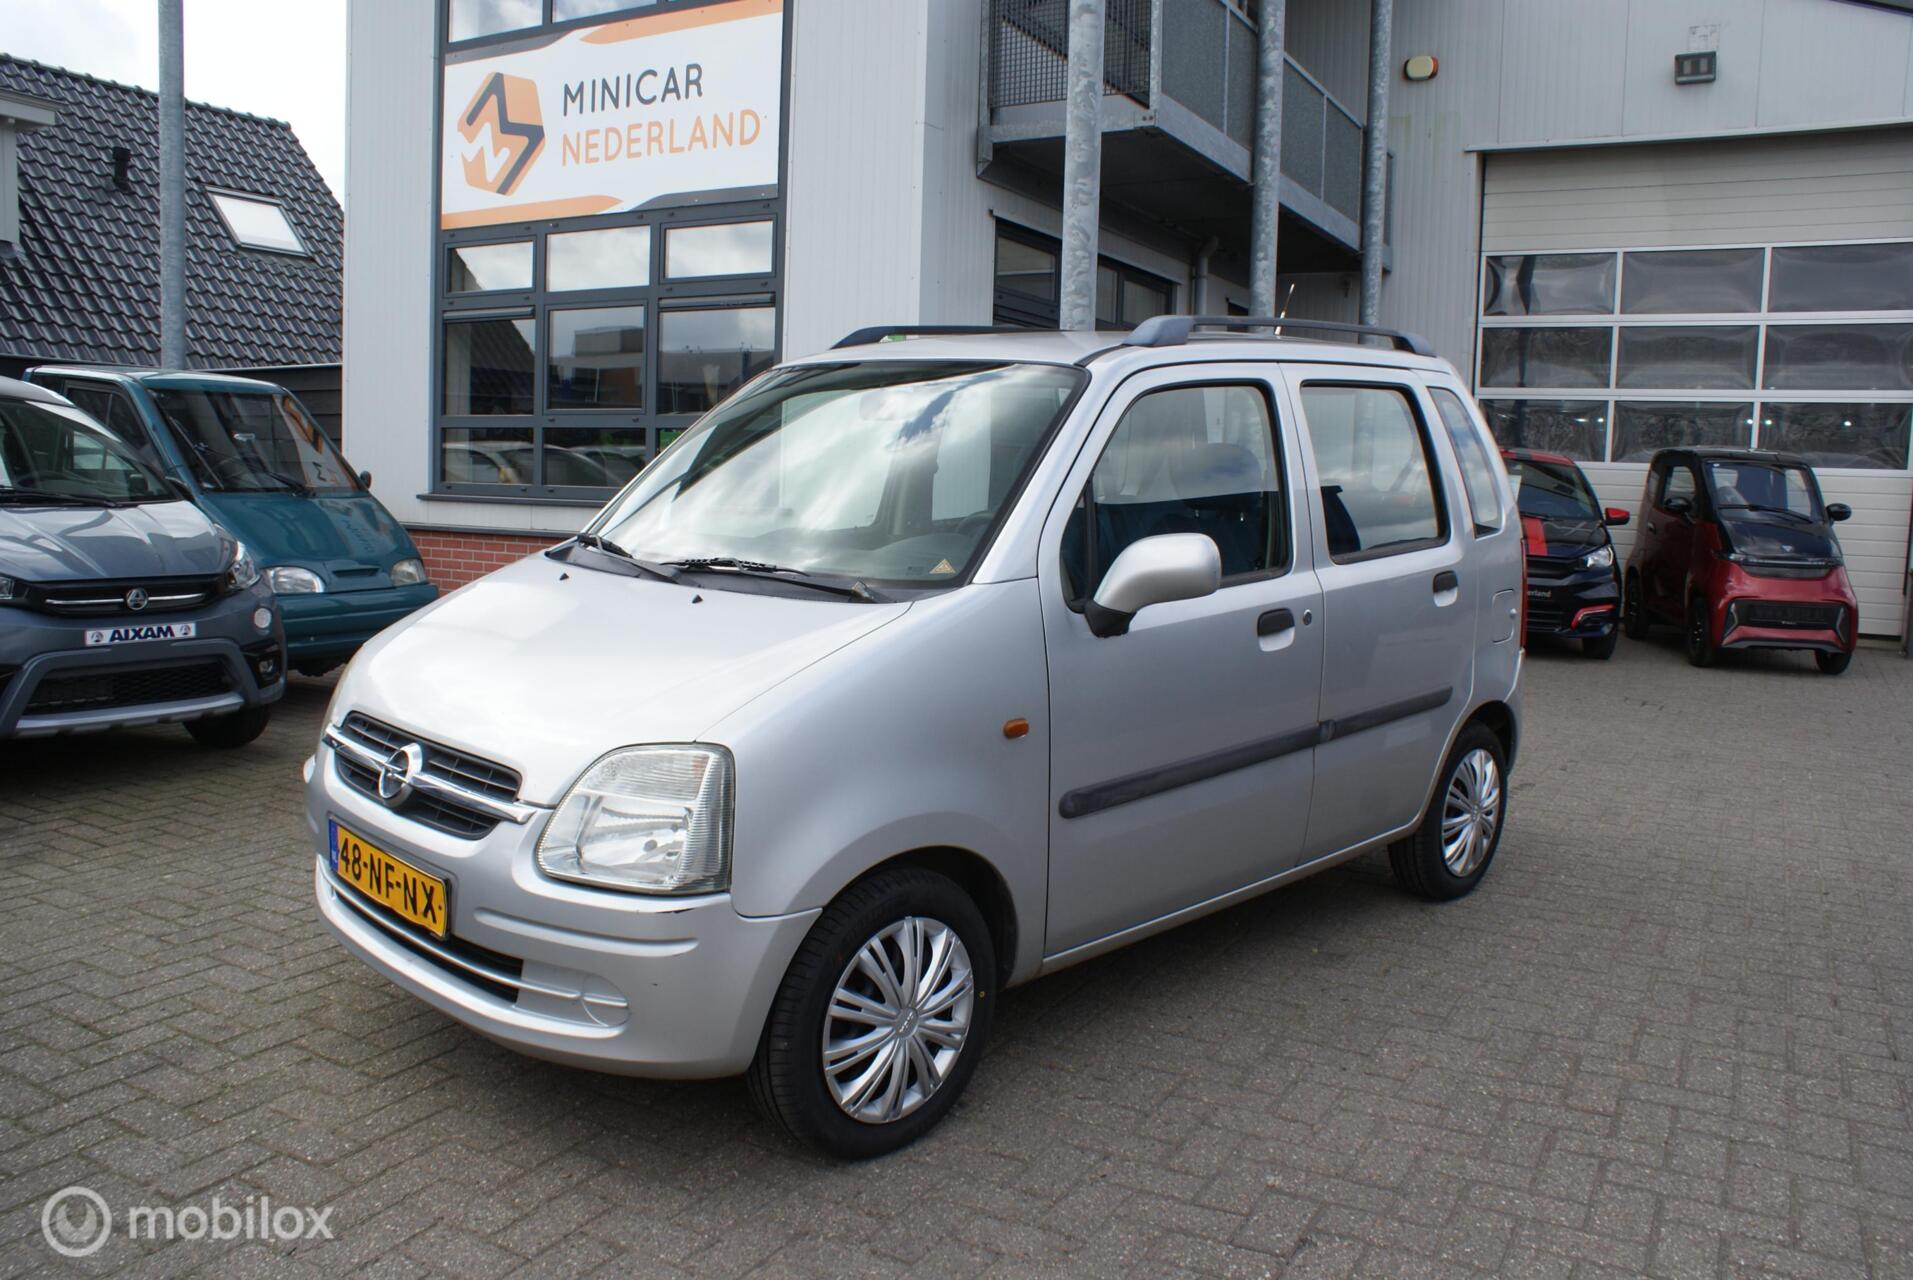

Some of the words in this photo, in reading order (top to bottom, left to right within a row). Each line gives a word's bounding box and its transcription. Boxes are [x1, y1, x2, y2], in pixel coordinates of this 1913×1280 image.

[562, 63, 704, 117] MINICAR
[561, 108, 761, 167] NEDERLAND
[1526, 589, 1552, 598] erland
[109, 625, 175, 642] AIXAM
[340, 837, 437, 924] 48-NF-NX
